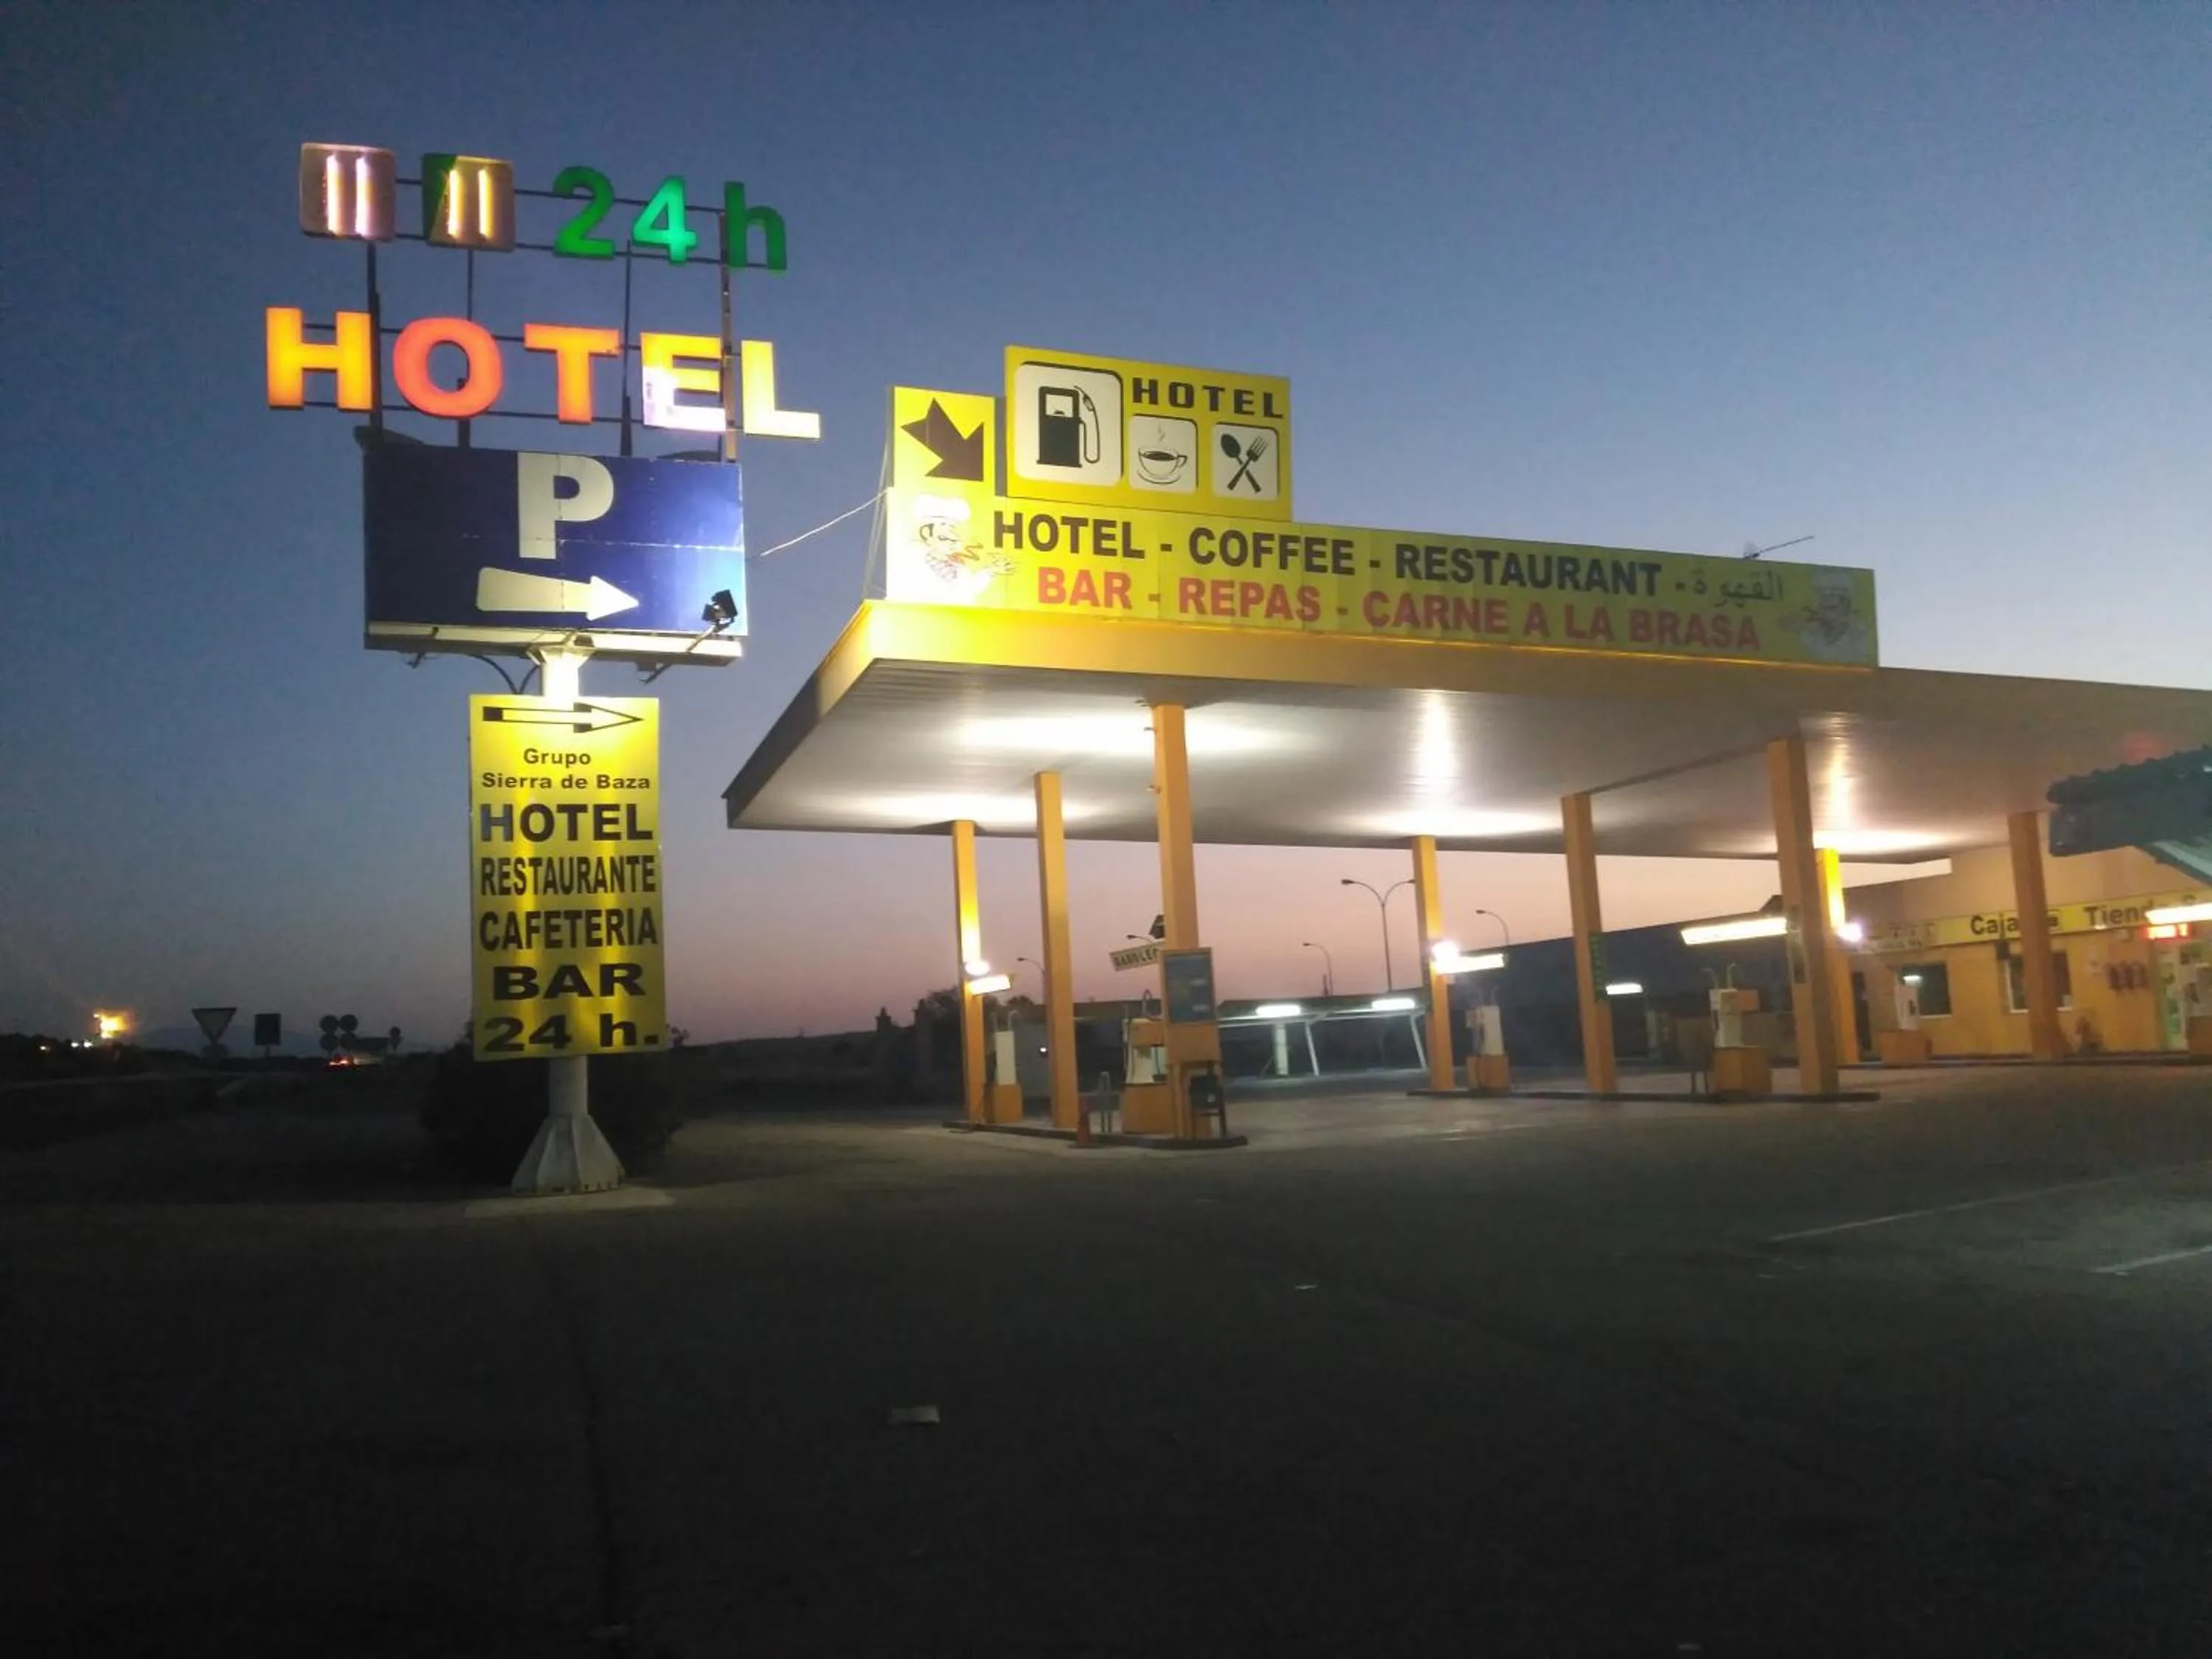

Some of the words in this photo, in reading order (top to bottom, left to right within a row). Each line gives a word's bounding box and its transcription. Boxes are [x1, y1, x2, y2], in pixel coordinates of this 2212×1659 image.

[266, 307, 821, 439] HOTEL
[1132, 377, 1284, 420] HOTEL
[518, 451, 615, 560] P
[994, 510, 1146, 560] HOTEL
[1189, 527, 1355, 576] COFFEE
[1395, 543, 1662, 597] RESTAURANT
[1038, 566, 1133, 610] BAR
[1179, 577, 1321, 622] REPAS
[1363, 591, 1509, 634] CARNE
[1523, 601, 1551, 639] A
[1564, 603, 1615, 642] LA
[1629, 608, 1761, 651] BRASA
[523, 748, 591, 769] Grupo
[481, 772, 552, 789] Sierra
[560, 774, 588, 790] de
[596, 774, 650, 790] Baza
[480, 803, 654, 842] HOTEL
[481, 855, 656, 897] RESTAURANTE
[479, 907, 658, 952] CAFETERIA
[493, 963, 646, 1001] BAR
[483, 1014, 572, 1052] 24
[599, 1013, 659, 1048] h.
